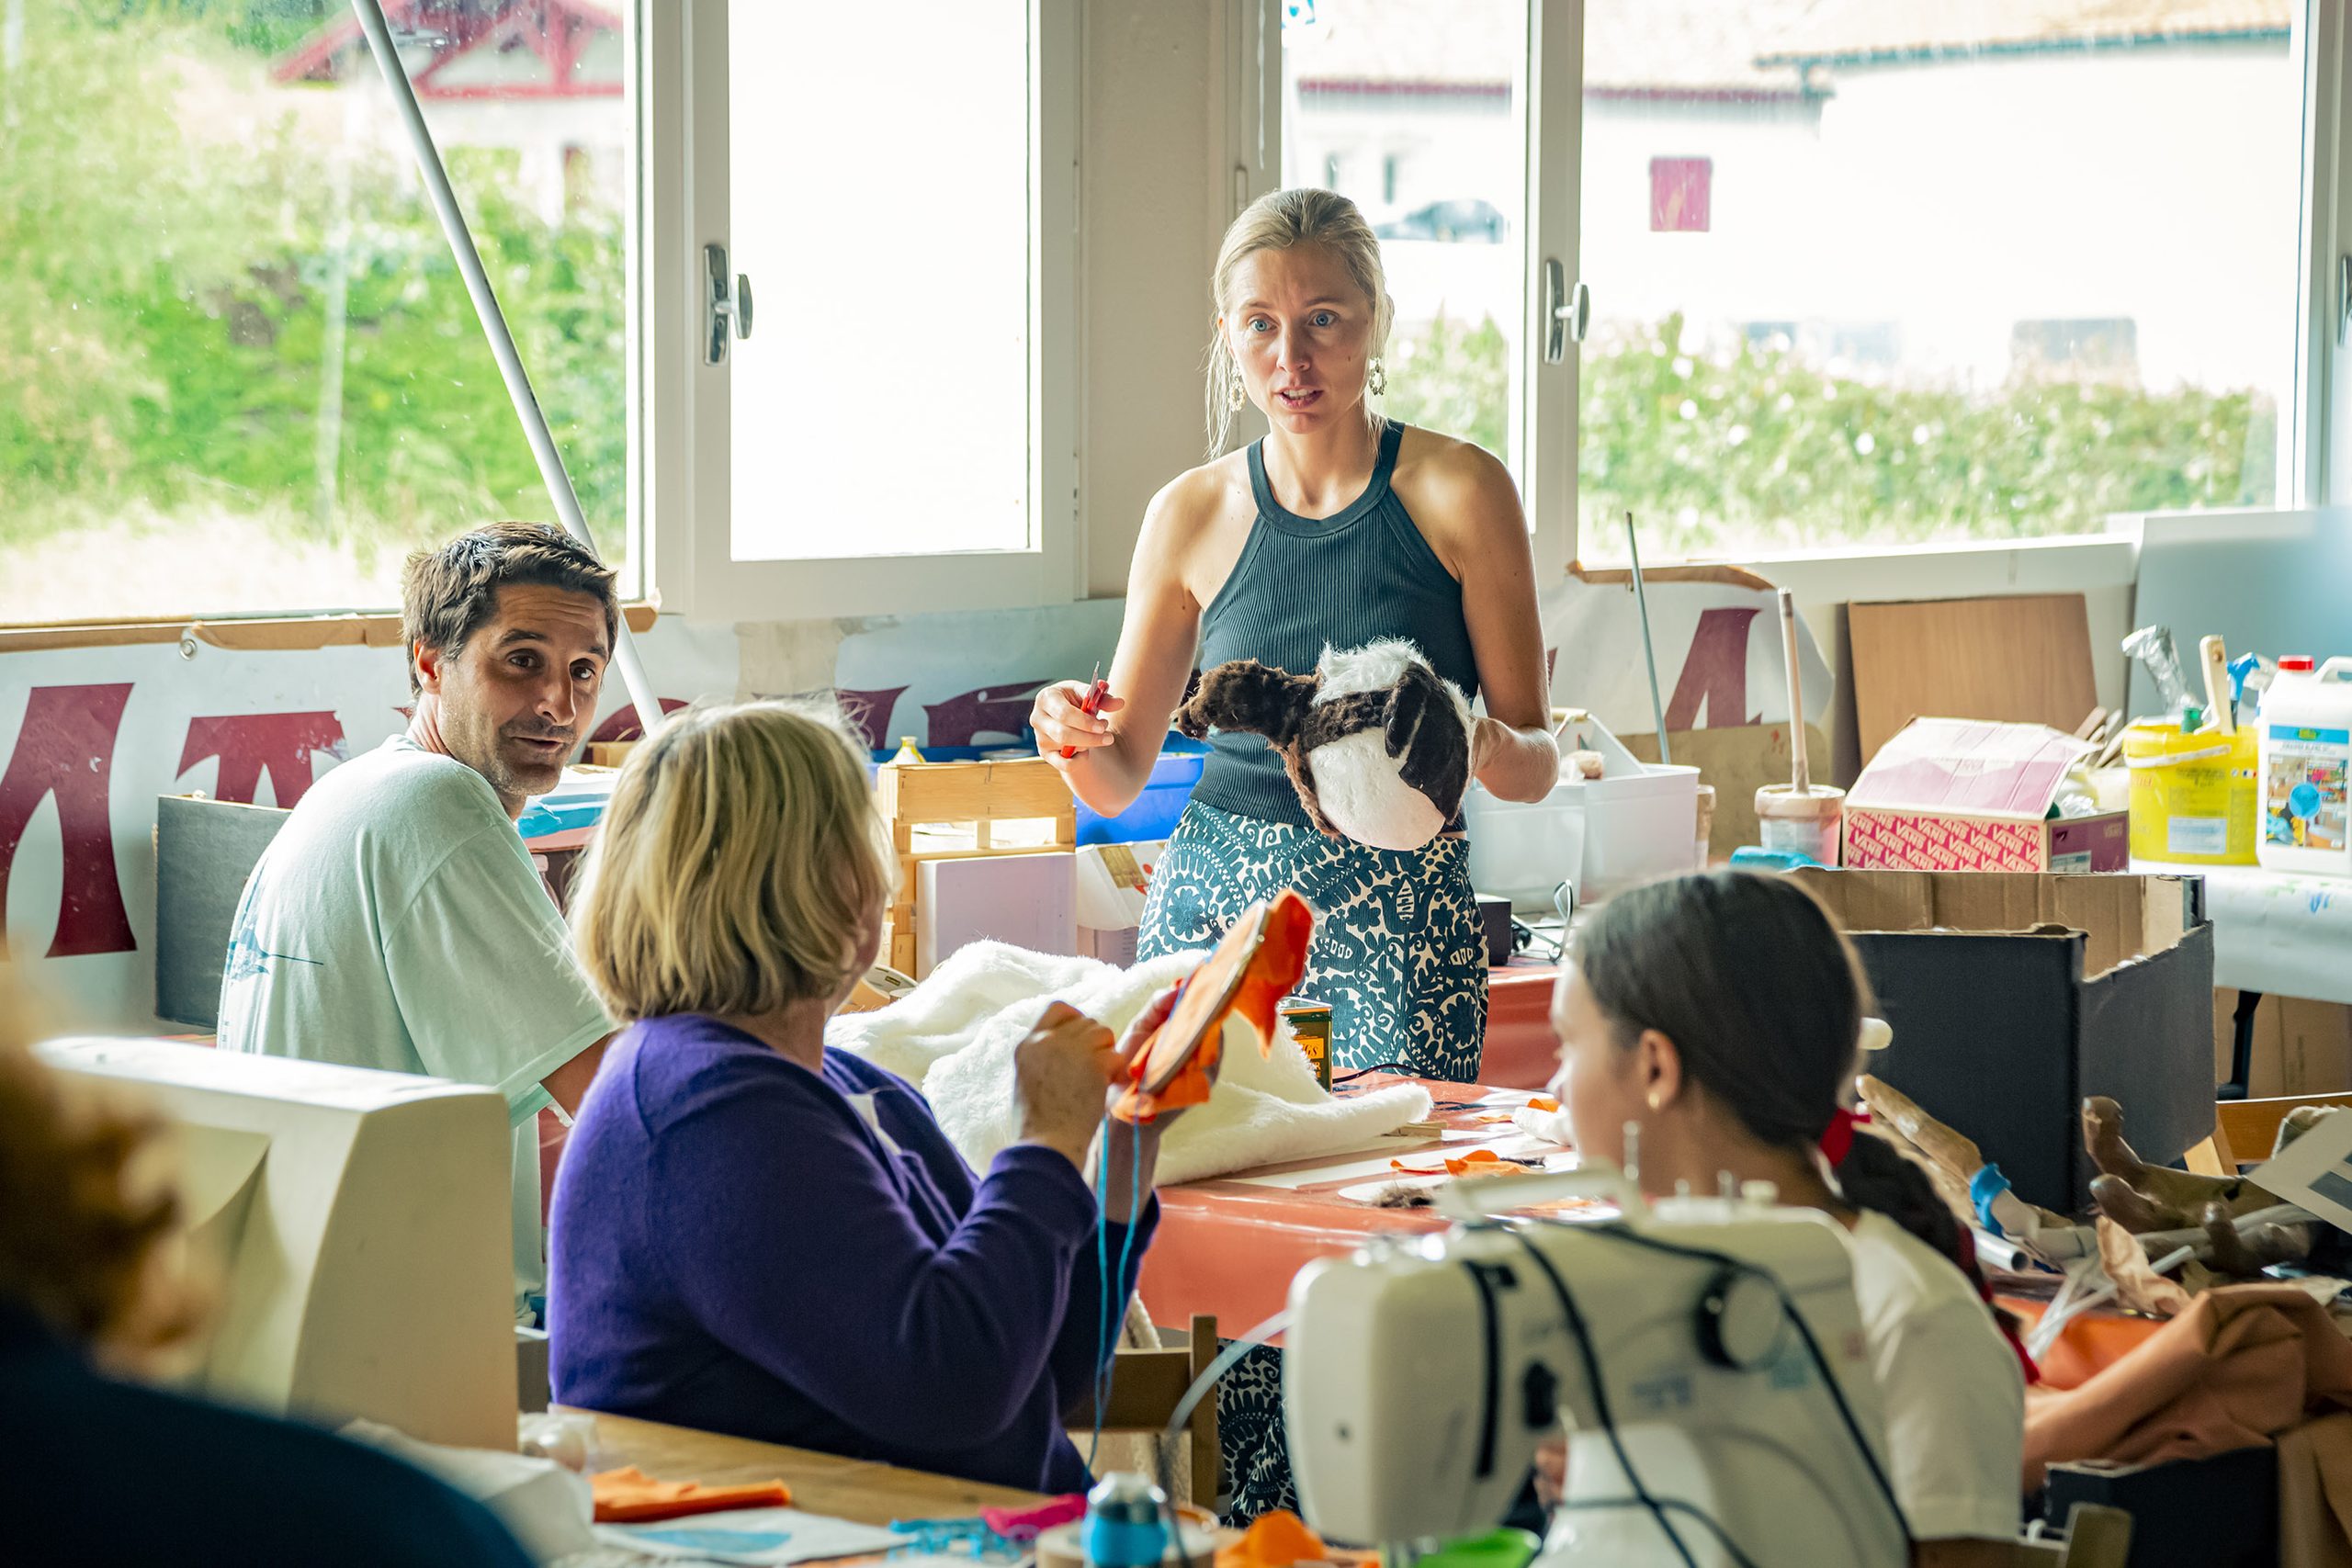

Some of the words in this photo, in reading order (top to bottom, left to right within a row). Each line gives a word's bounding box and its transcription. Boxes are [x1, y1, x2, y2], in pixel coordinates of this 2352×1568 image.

[1854, 829, 1884, 860] VANS
[1875, 823, 1905, 855] VANS
[1895, 819, 1928, 850] VANS
[1917, 817, 1949, 846] VANS
[1971, 829, 2002, 861] VANS
[1993, 824, 2025, 855] VANS
[1927, 839, 1958, 871] VANS
[1949, 834, 1981, 866] VANS
